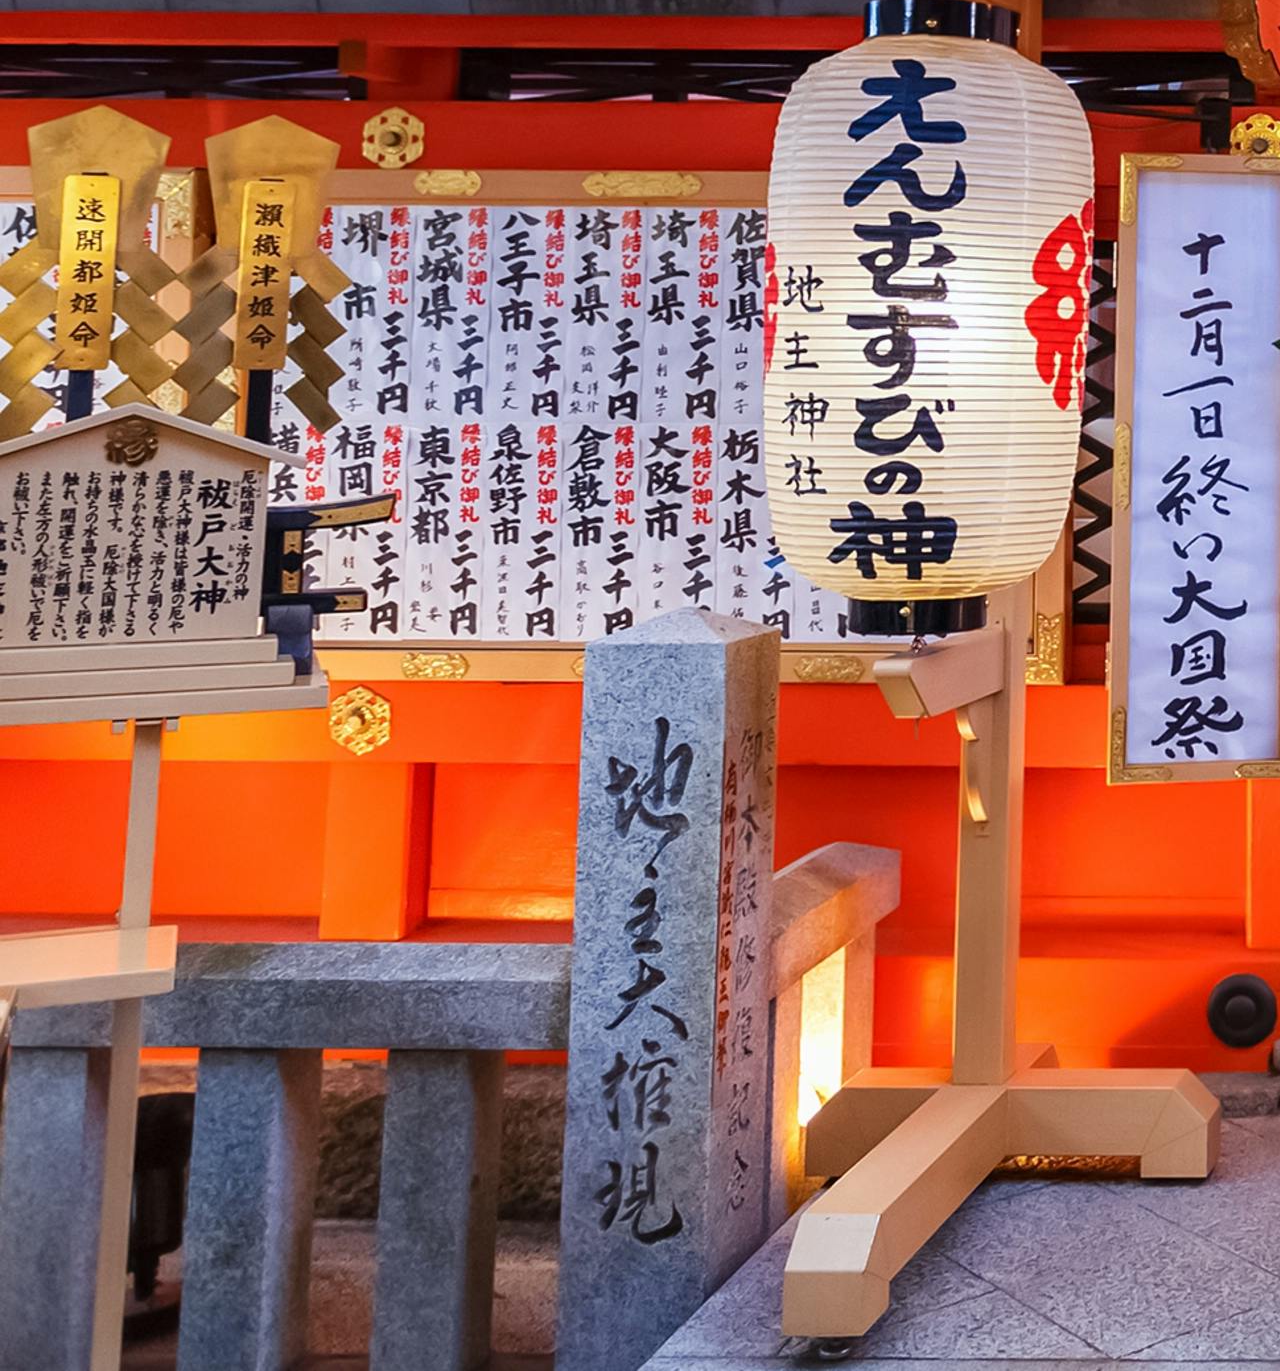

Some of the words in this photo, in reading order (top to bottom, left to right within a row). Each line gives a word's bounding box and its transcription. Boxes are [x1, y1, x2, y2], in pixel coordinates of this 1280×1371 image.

[342, 210, 388, 320] 堺市
[417, 209, 463, 331] 宮城県
[465, 207, 489, 305] 縁結び御礼
[497, 211, 541, 332] 八王子市
[544, 209, 565, 308] 縁結び御礼
[571, 209, 619, 326] 埼玉県
[620, 209, 642, 309] 縁結び御礼
[648, 210, 697, 326] 埼玉県
[698, 209, 719, 308] 縁結び御礼
[725, 210, 766, 333] 佐賀県
[377, 311, 408, 415] 三千円
[453, 315, 485, 416] 三千円
[531, 317, 562, 418] 三千円
[608, 318, 641, 421] 三千円
[685, 316, 717, 420] 三千円
[827, 58, 968, 580] えんむすびの神
[782, 264, 829, 497] 地主神社
[411, 426, 455, 545] 東京都
[459, 424, 481, 523] 縁結び御礼
[489, 424, 531, 546] 泉佐野市
[536, 425, 558, 525] 縁結び御礼
[566, 426, 612, 547] 倉敷市
[614, 425, 635, 526] 縁結び御礼
[643, 426, 693, 542] 大阪市
[692, 425, 714, 526] 縁結び御礼
[719, 428, 767, 554] 栃木県
[1151, 231, 1250, 760] 十二月一日終い大国祭
[188, 478, 233, 615] 祓戸大神
[370, 532, 400, 635] 三千円
[450, 530, 478, 636] 三千円
[525, 530, 557, 637] 三千円
